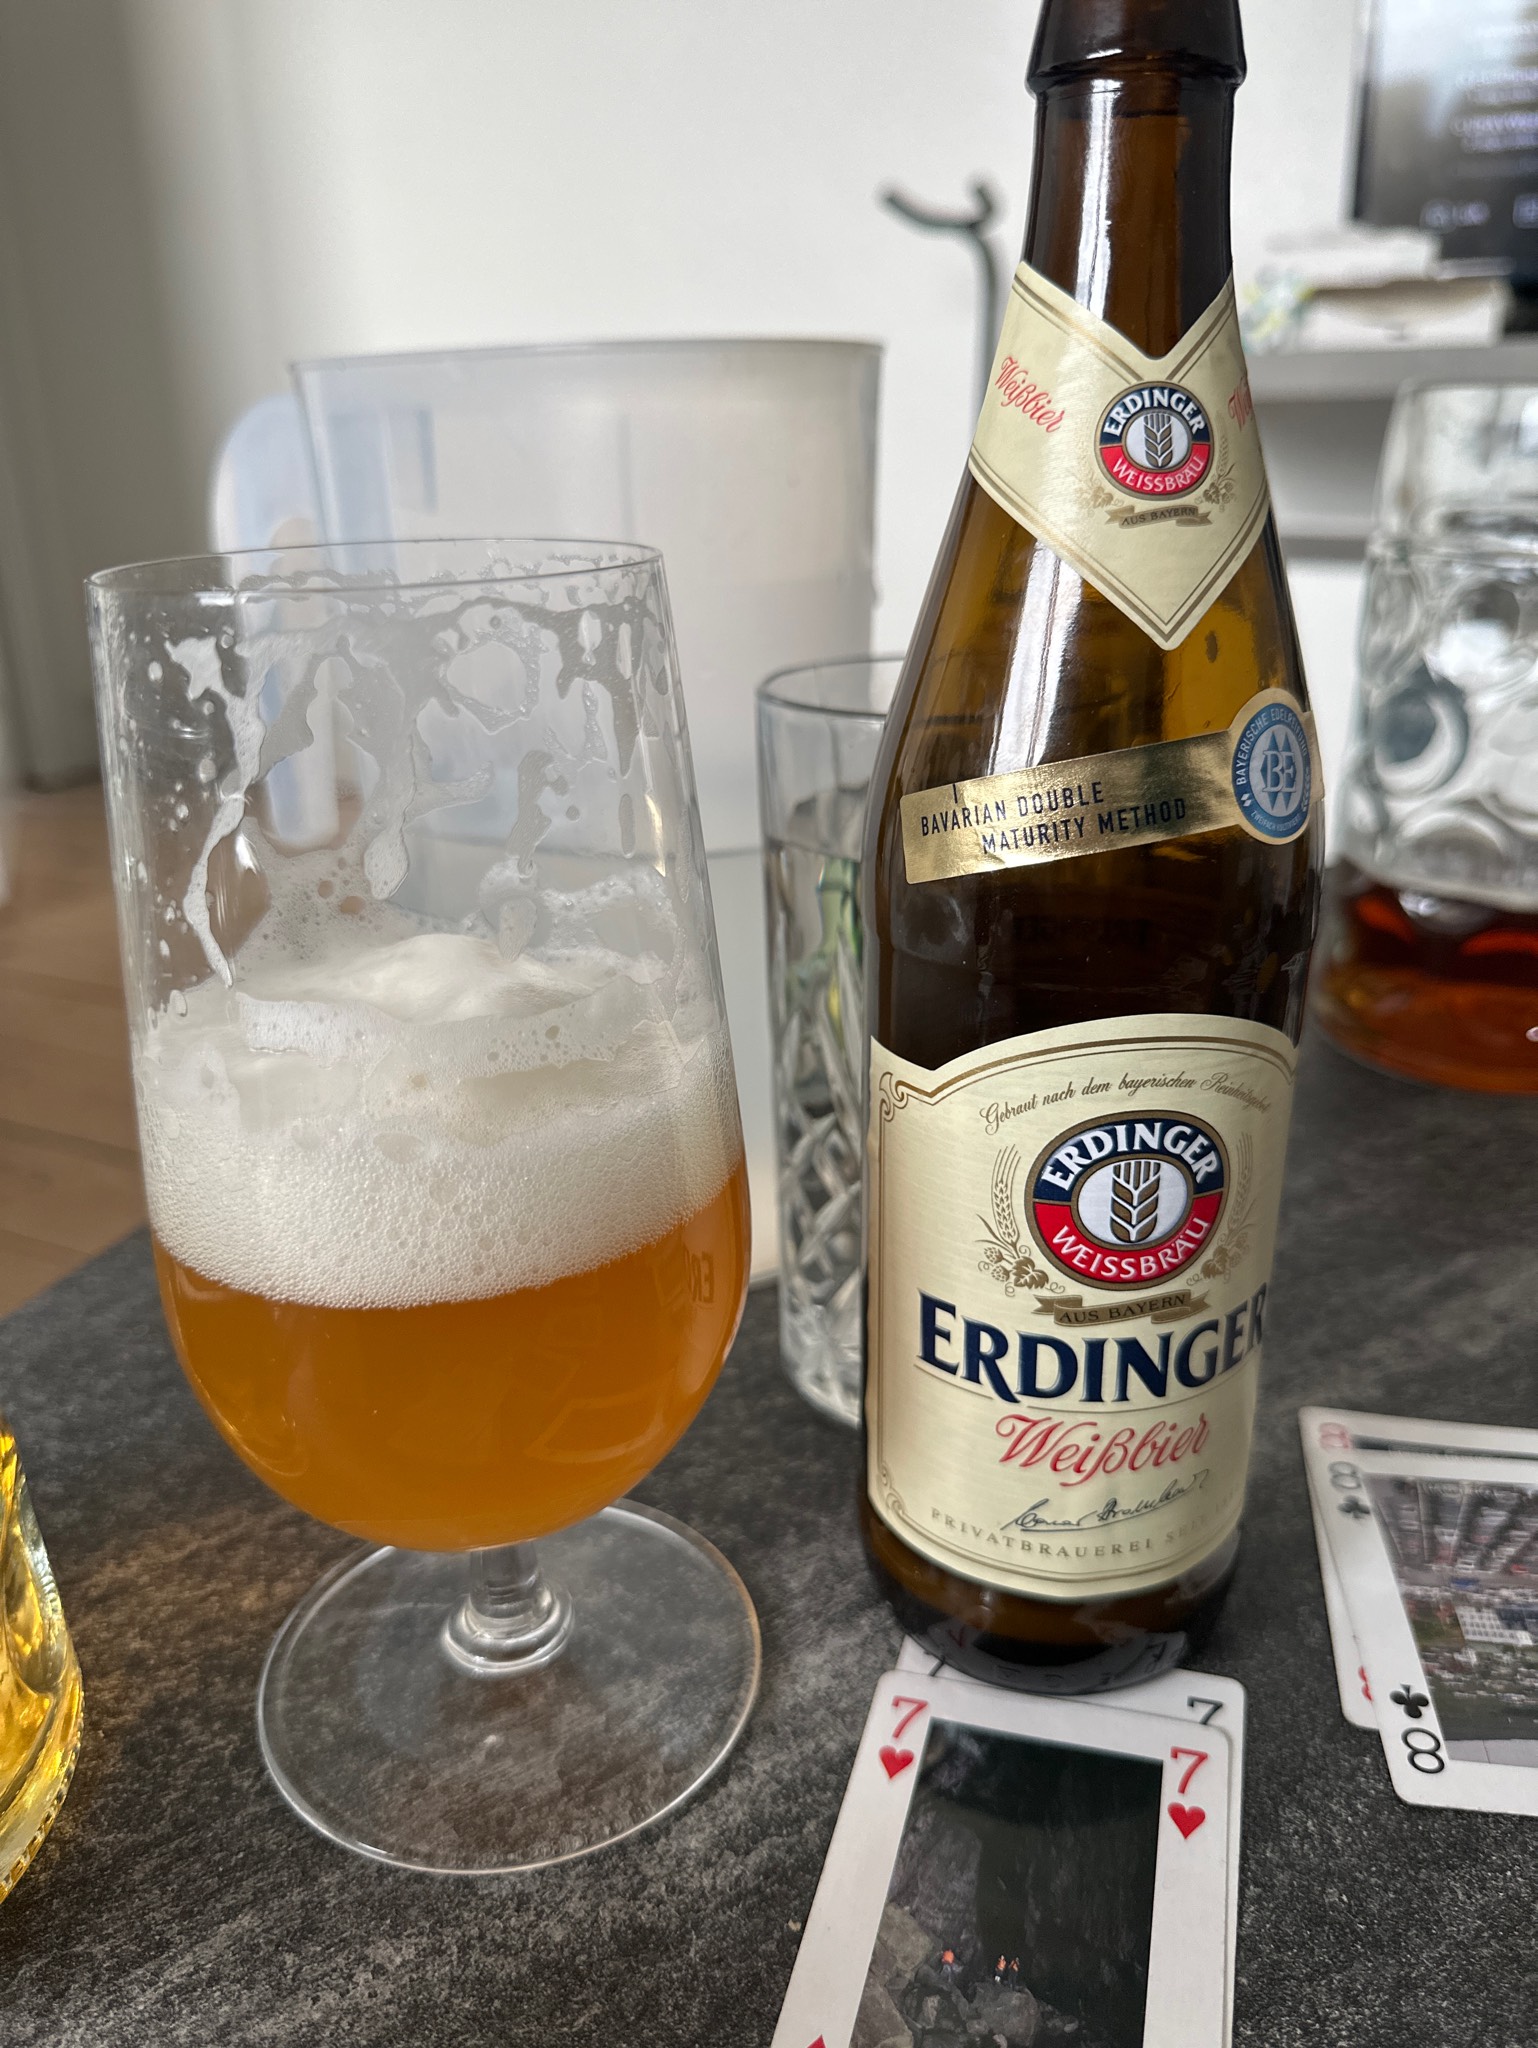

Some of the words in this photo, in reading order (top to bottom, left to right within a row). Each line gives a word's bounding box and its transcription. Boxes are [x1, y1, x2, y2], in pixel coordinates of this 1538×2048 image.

[994, 355, 1066, 433] Weißbier
[1103, 387, 1207, 436] ERDINGER
[1112, 455, 1206, 494] WEISSBRÄU
[1121, 515, 1148, 527] AUS
[1150, 506, 1197, 521] BAYERN
[1235, 712, 1269, 786] BAYERISCHE
[1262, 750, 1297, 792] BE
[920, 798, 1008, 837] BAVARIAN
[1017, 780, 1105, 817] DOUBLE
[981, 817, 1085, 855] MATURITY
[1098, 797, 1187, 835] METHOD
[979, 1096, 1039, 1136] Gebraut
[1041, 1086, 1076, 1108] nach
[1081, 1077, 1112, 1097] dem
[1118, 1072, 1199, 1098] bayerischen
[1041, 1121, 1220, 1191] ERDINGER
[1051, 1216, 1210, 1279] WEISSBRÄU
[1058, 1308, 1101, 1324] AUS
[1107, 1293, 1188, 1320] BAYERN
[916, 1282, 1267, 1404] ERDINGER
[995, 1412, 1211, 1488] Weißbier
[1328, 1460, 1362, 1491] 8
[930, 1506, 1152, 1560] PRIVATBRAUEREI
[891, 1696, 928, 1740] 7
[1170, 1746, 1208, 1795] 7
[1400, 1726, 1446, 1775] 8
